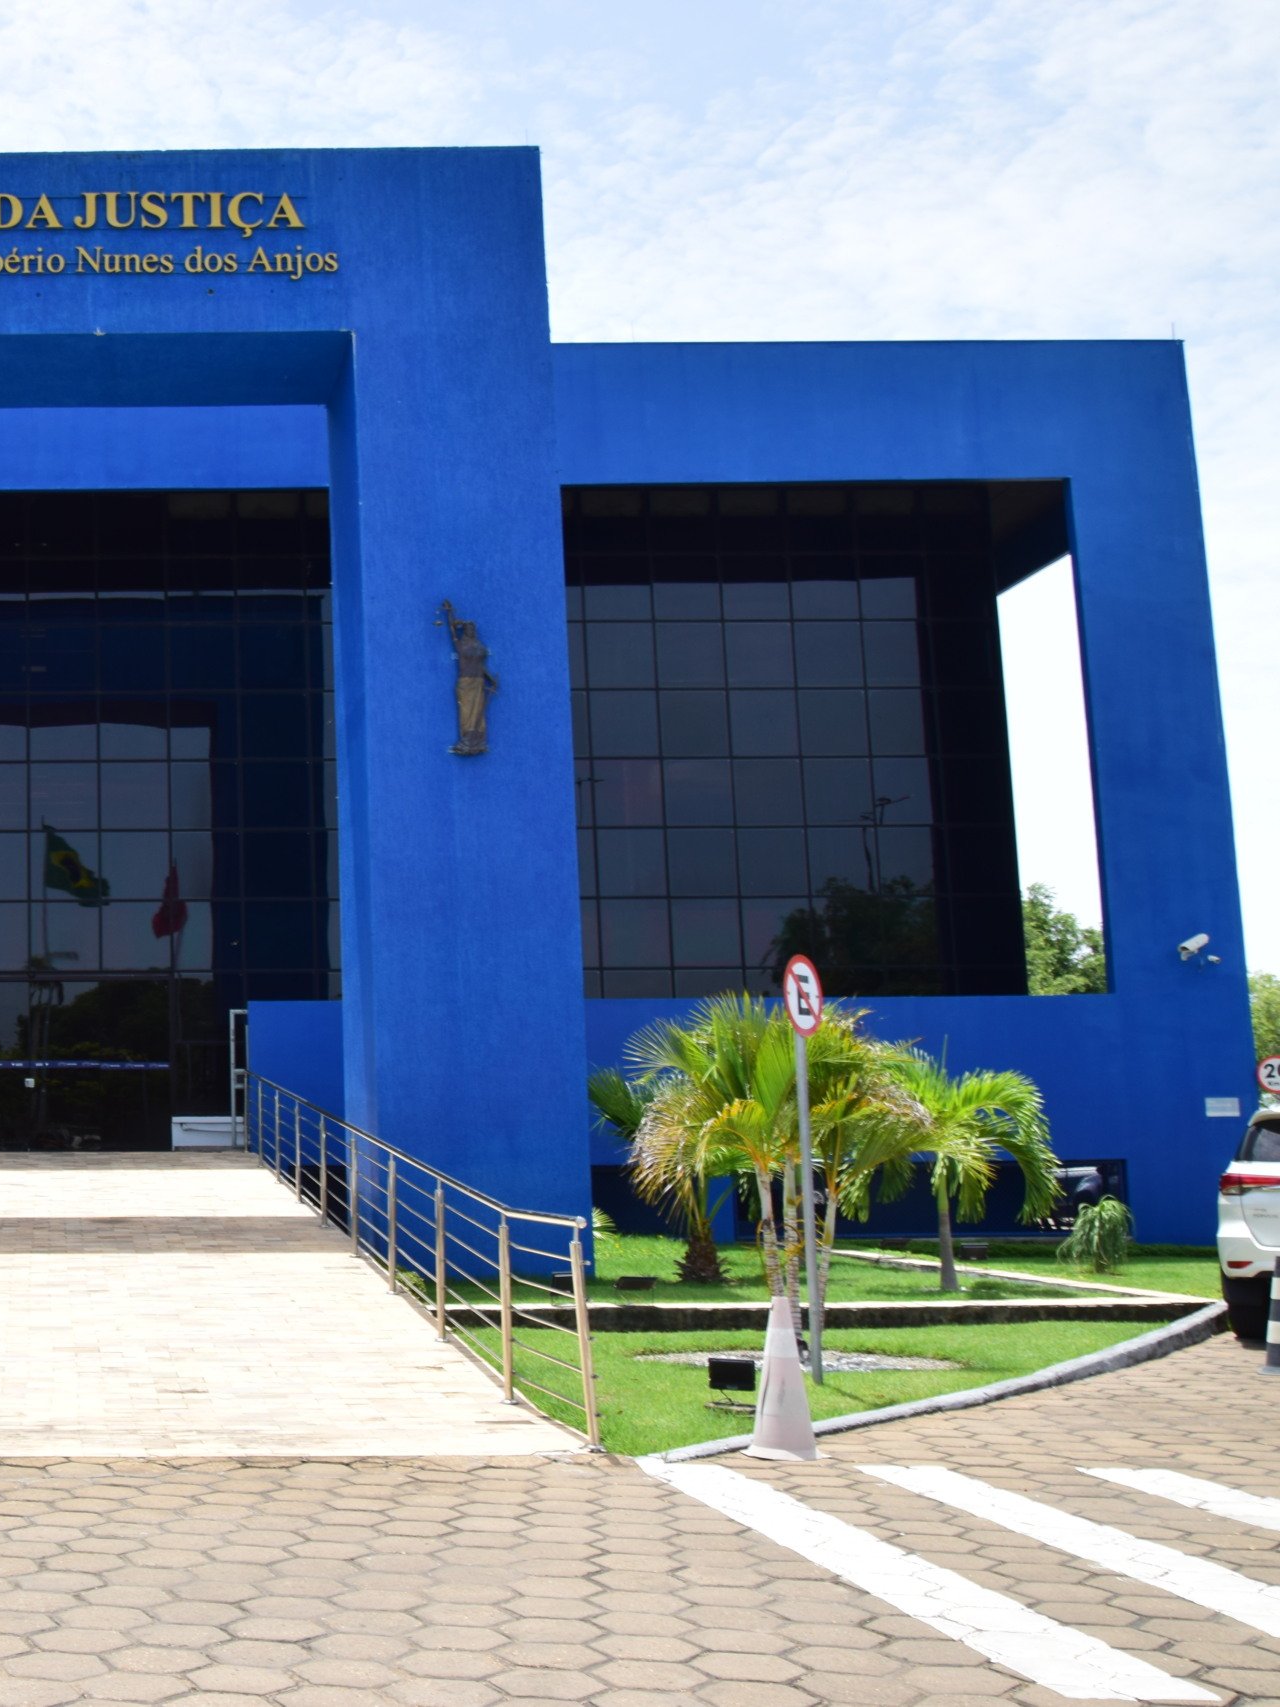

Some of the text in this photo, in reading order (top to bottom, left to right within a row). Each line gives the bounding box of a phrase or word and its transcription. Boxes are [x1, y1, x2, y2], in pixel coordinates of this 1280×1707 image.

[73, 191, 305, 238] JUSTIÇA
[76, 246, 174, 274] Nunes
[184, 246, 238, 273] dos
[247, 245, 338, 280] Anjos
[796, 974, 811, 1016] E
